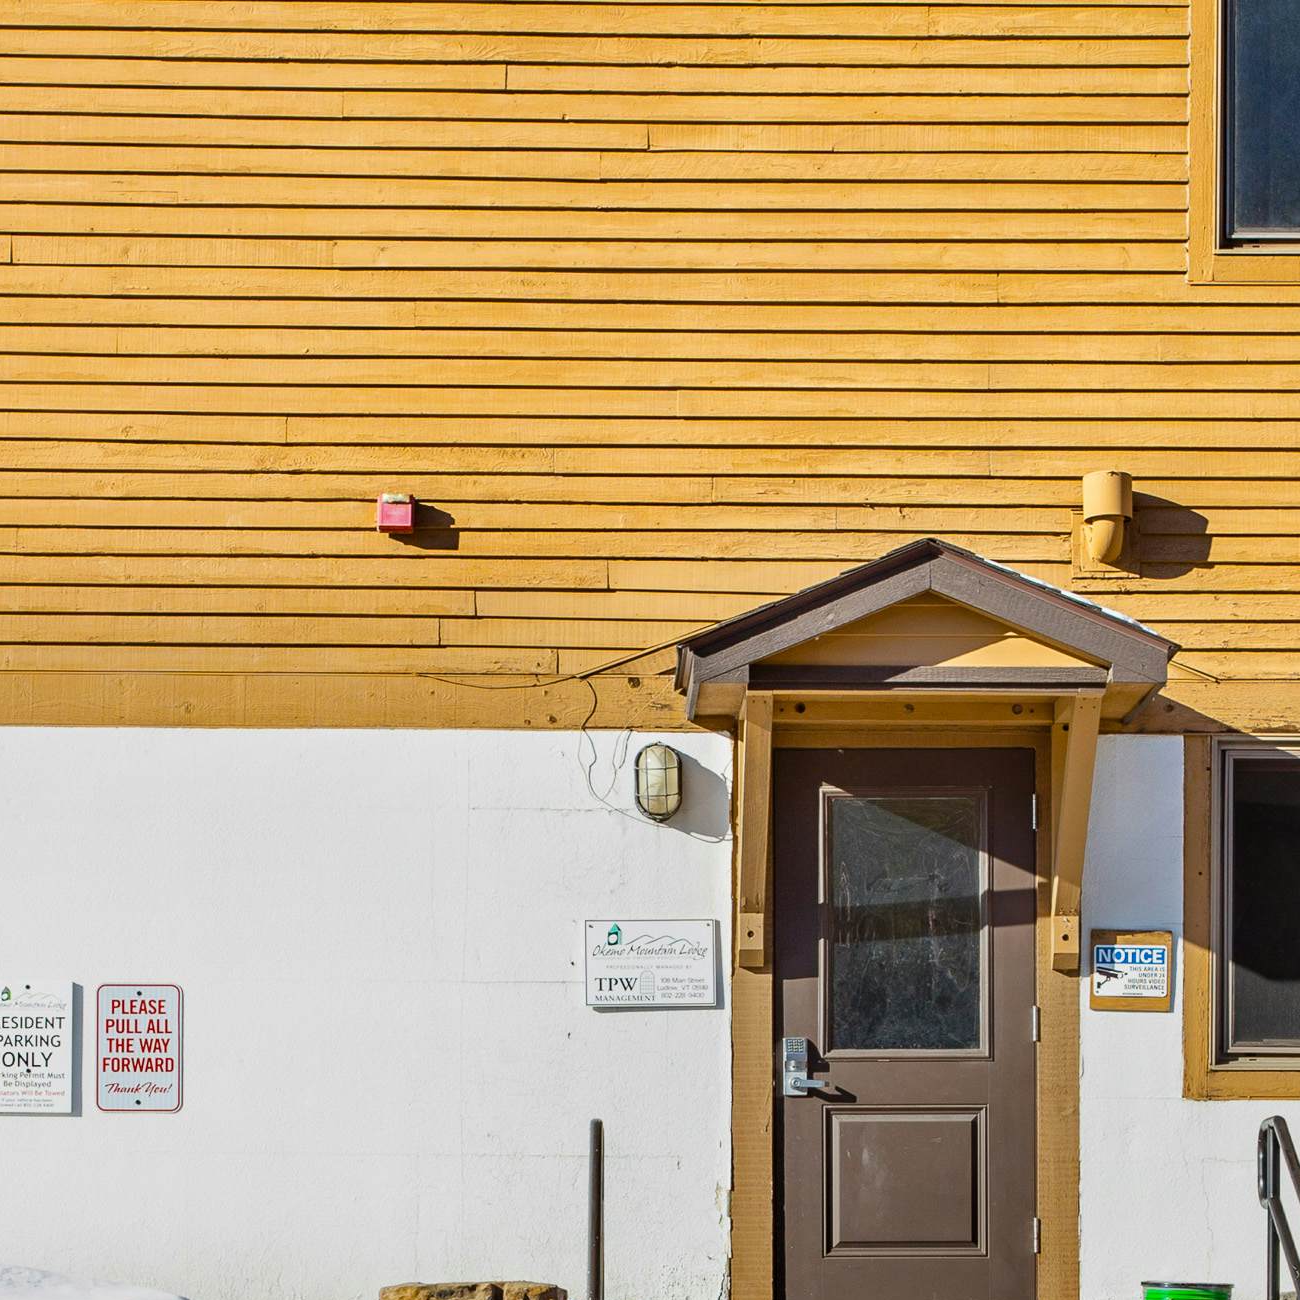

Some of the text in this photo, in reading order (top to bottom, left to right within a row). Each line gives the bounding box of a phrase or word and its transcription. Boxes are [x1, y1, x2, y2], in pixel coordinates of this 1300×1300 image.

[626, 944, 677, 957] Mountain
[679, 941, 708, 960] Lodge
[1098, 948, 1164, 964] NOTICE
[594, 977, 638, 992] TPW
[594, 994, 656, 1002] MANAGEMENT
[111, 999, 166, 1015] PLEASE
[105, 1019, 172, 1034] PULL ALL
[106, 1038, 170, 1053] THE WAY
[2, 1052, 53, 1068] ONLY
[102, 1057, 174, 1073] FORWARD
[14, 1080, 52, 1088] Displayed
[105, 1082, 173, 1098] Thank You!
